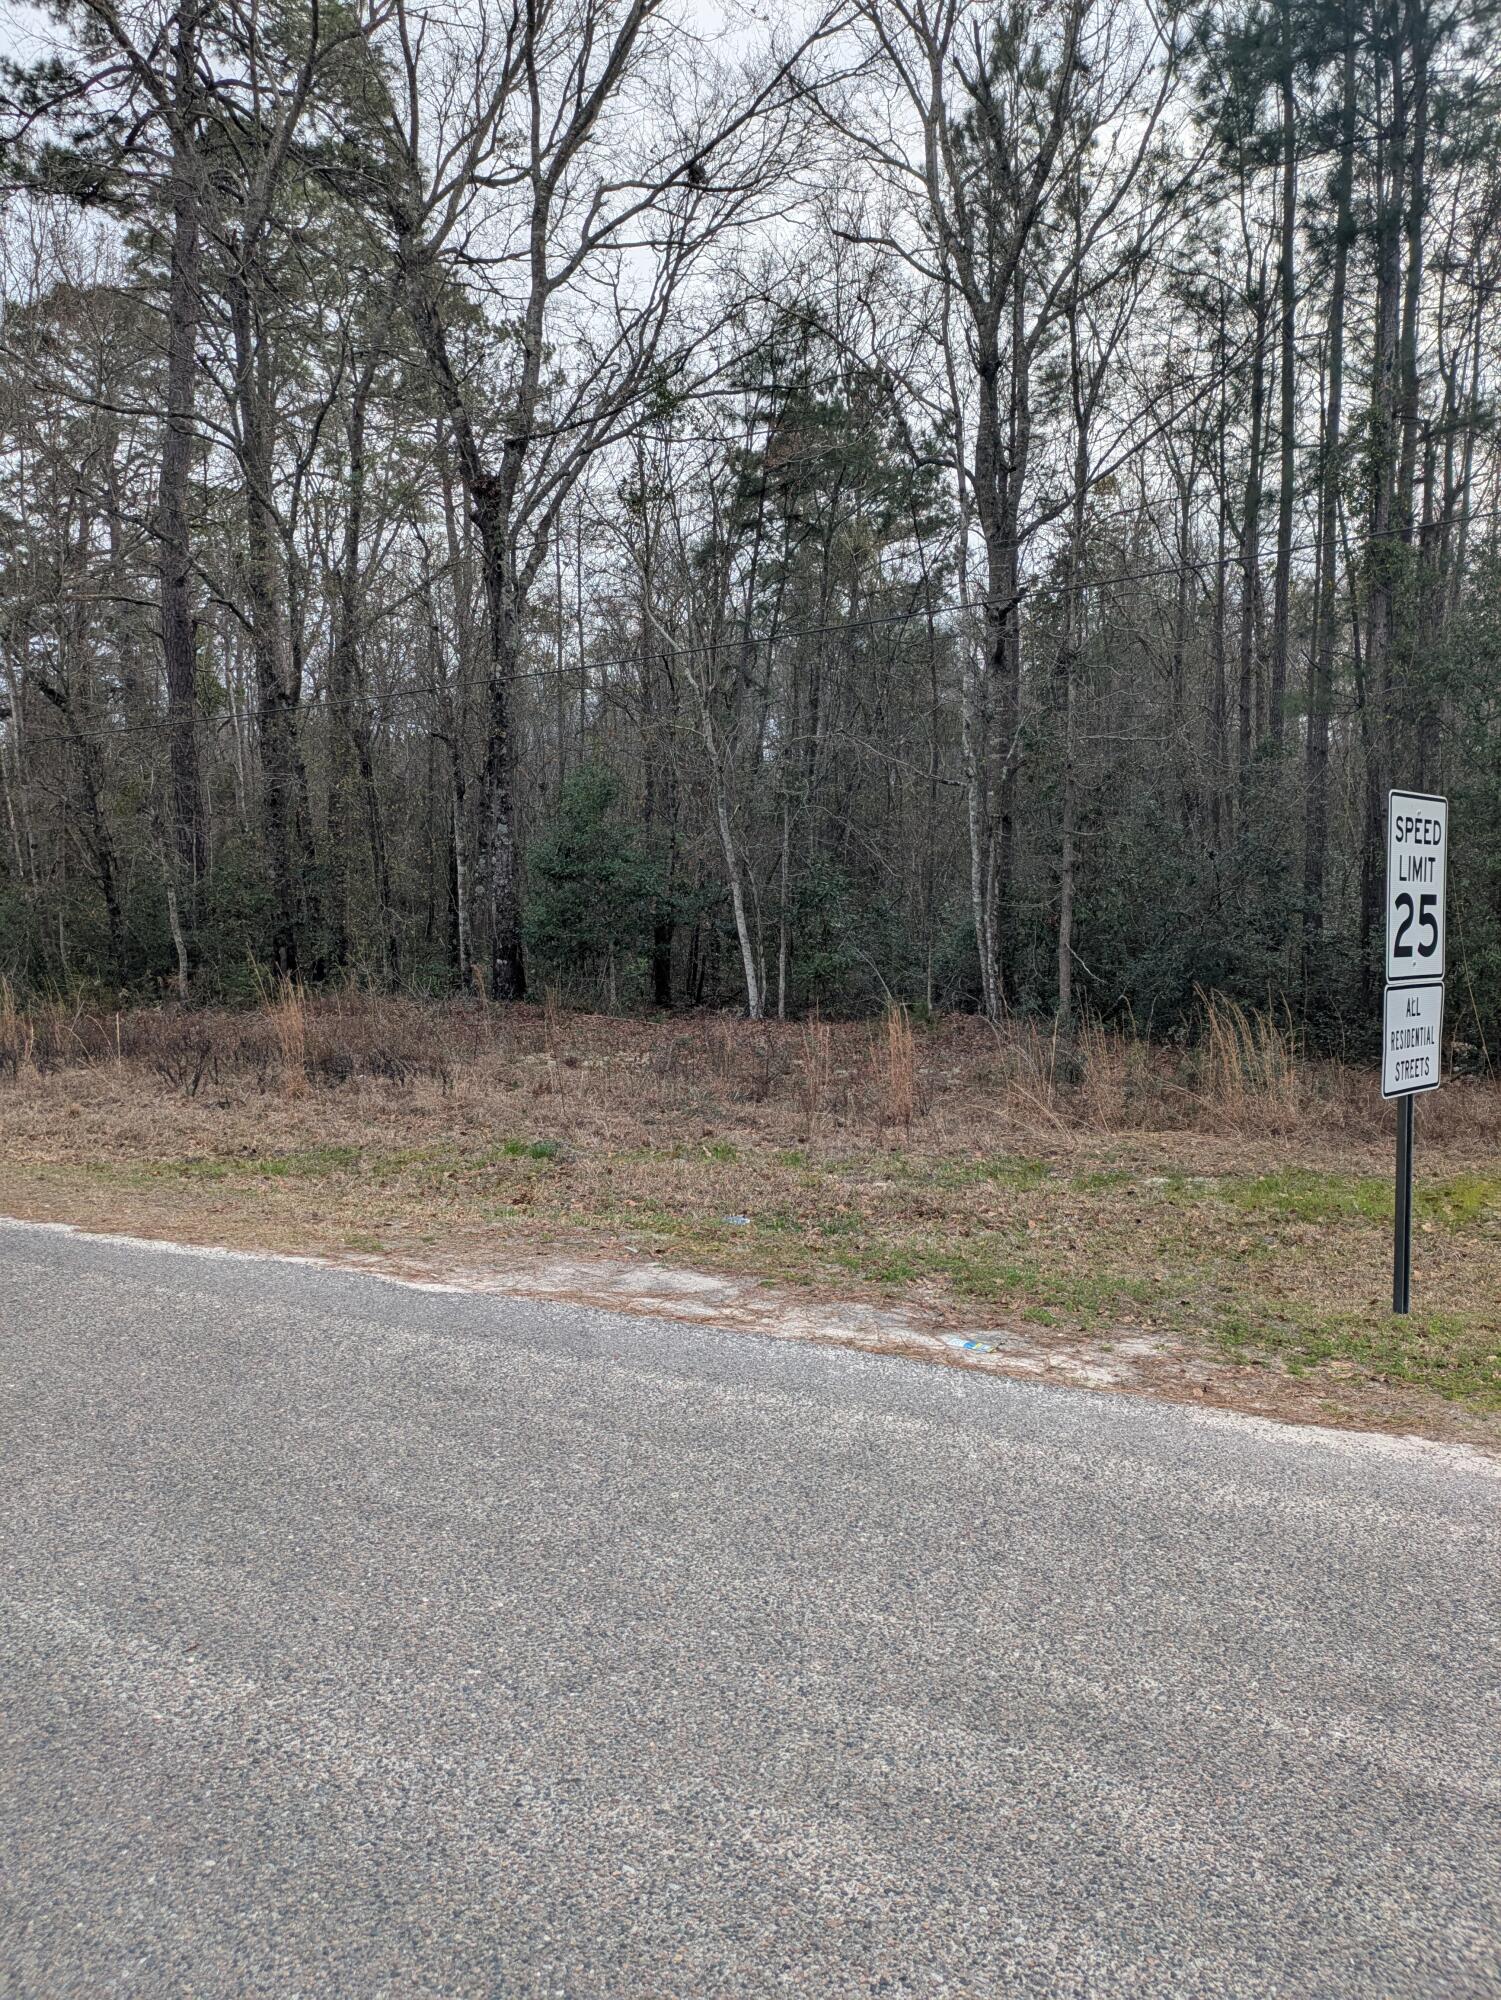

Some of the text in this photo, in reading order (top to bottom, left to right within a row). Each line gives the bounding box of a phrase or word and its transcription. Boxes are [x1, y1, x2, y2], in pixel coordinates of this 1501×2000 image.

[1395, 815, 1442, 846] SPEED
[1399, 854, 1436, 883] LIMIT
[1393, 892, 1438, 958] 25
[1406, 997, 1421, 1018] ALL
[1391, 1025, 1435, 1052] RESIDENTIAL
[1395, 1056, 1430, 1082] STREETS
